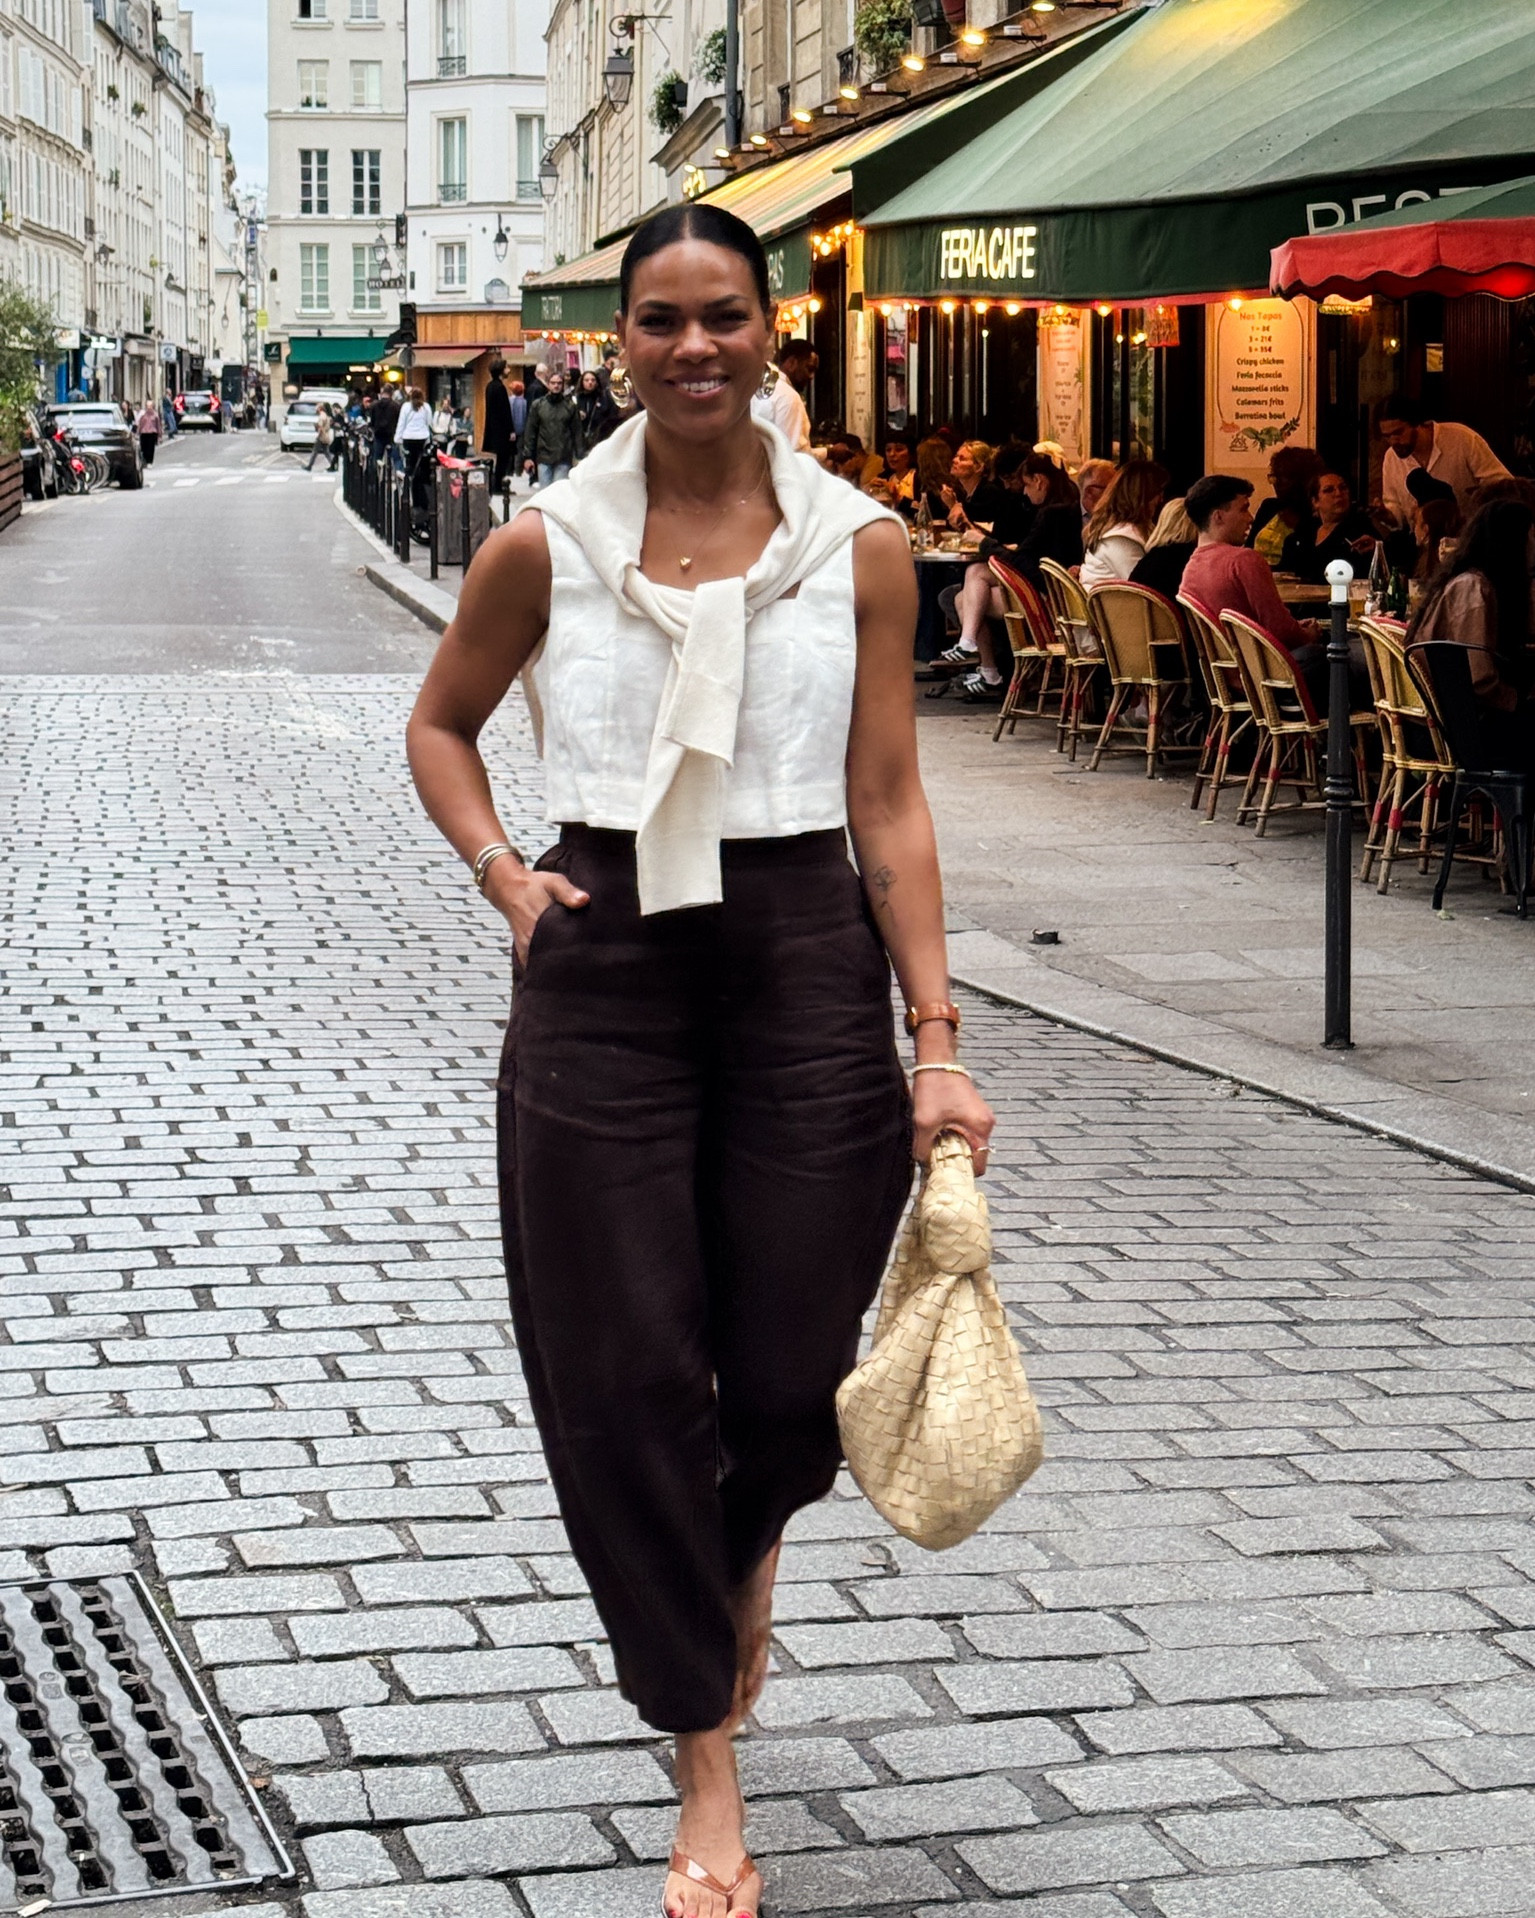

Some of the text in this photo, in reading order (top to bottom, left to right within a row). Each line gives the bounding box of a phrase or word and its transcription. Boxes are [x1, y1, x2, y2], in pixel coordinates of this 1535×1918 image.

[941, 226, 1037, 280] FERIA CAFE
[1257, 312, 1282, 321] Tapas
[1236, 357, 1285, 366] Crispy chicken
[1270, 384, 1289, 392] sticks
[1269, 397, 1284, 408] frits
[1269, 411, 1286, 419] bowl
